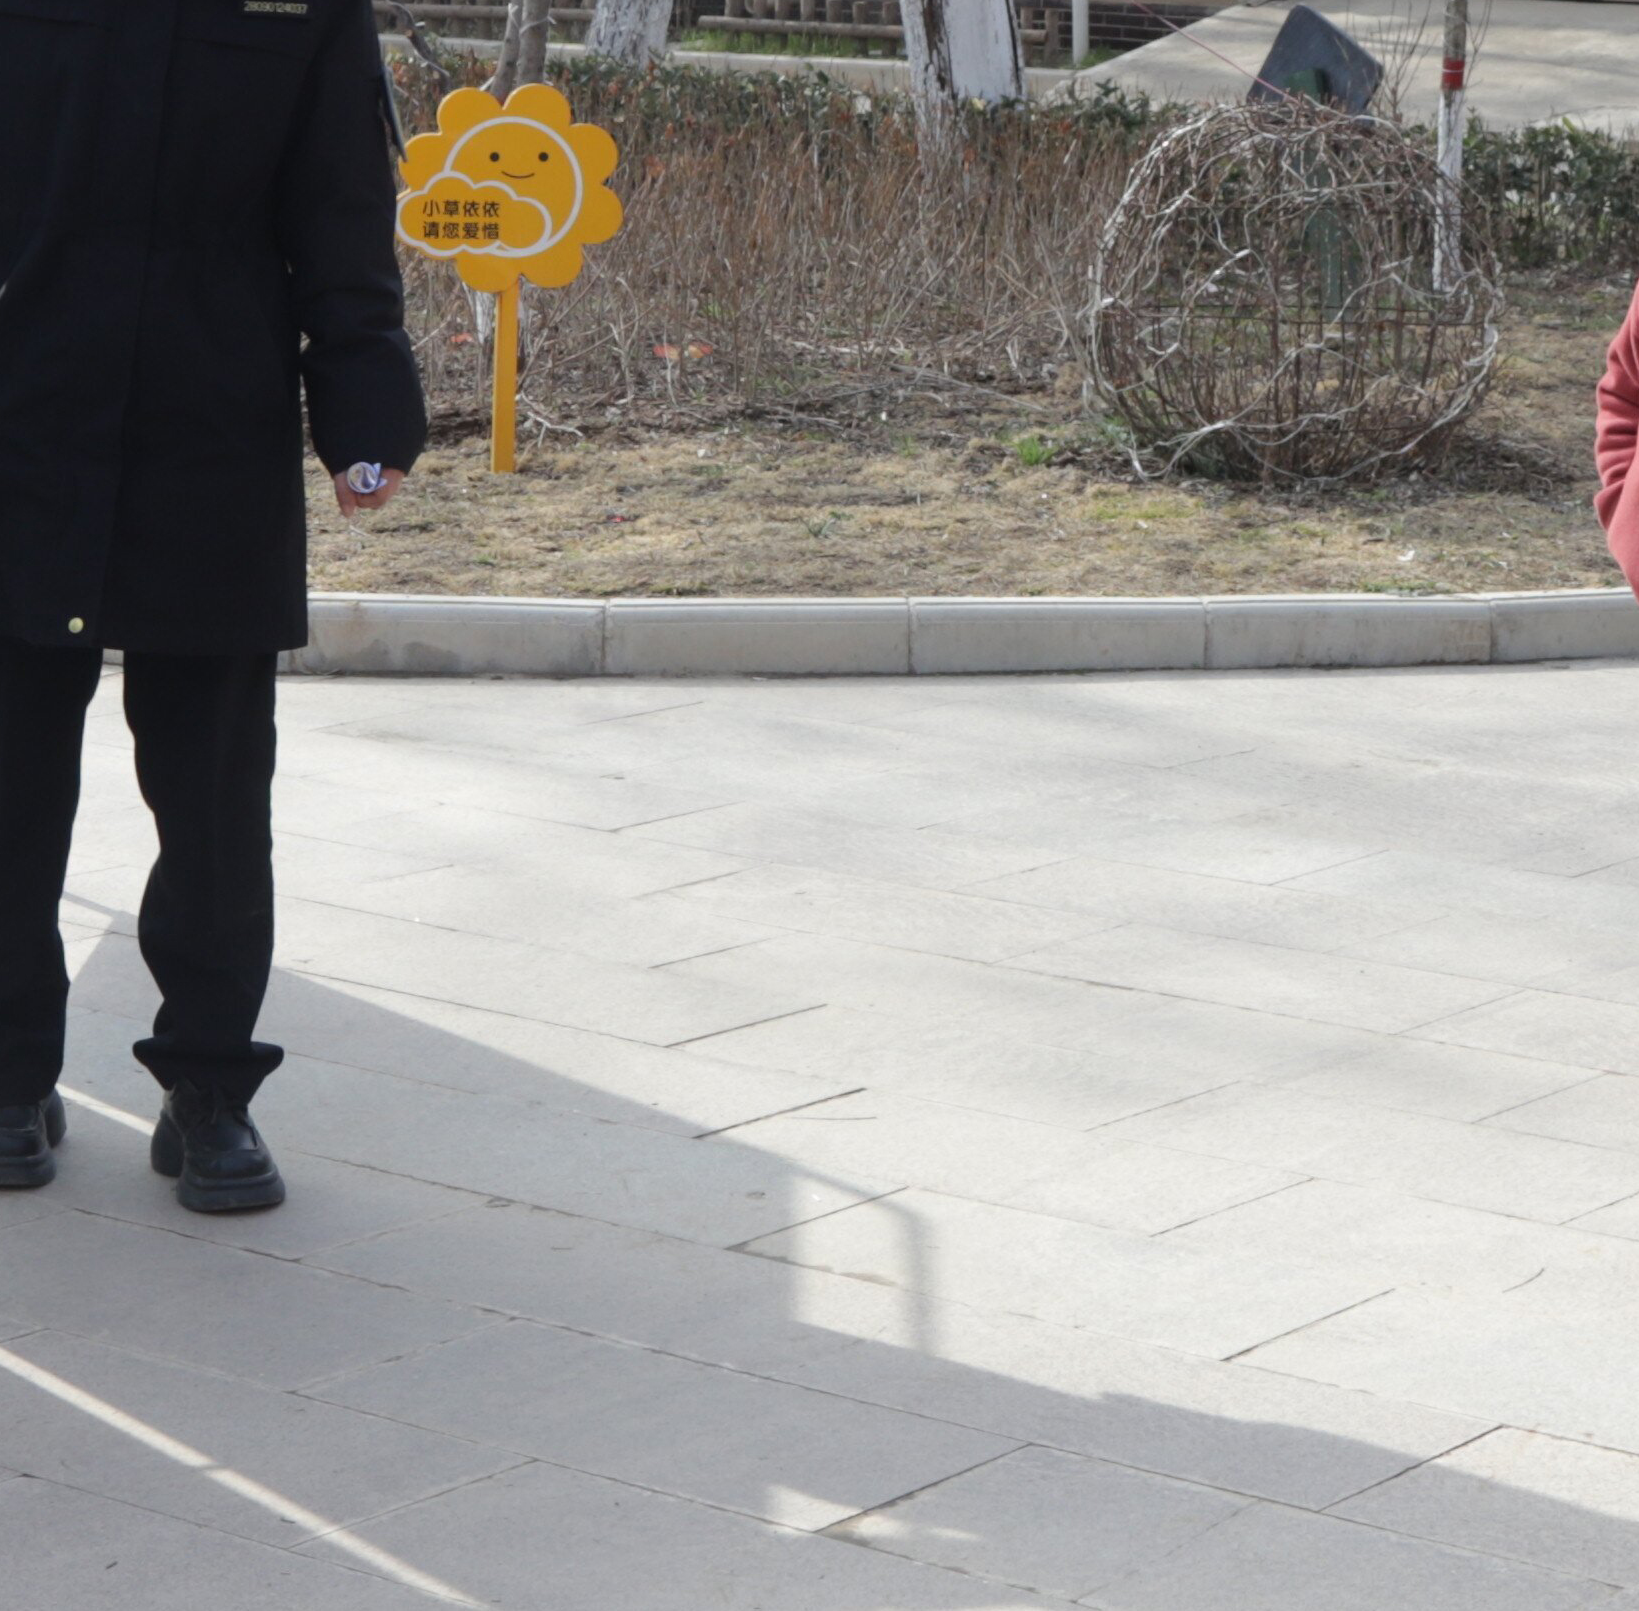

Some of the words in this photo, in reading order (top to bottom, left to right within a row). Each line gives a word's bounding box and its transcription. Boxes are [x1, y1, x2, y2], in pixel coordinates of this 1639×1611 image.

[422, 200, 500, 218] 小草依依
[422, 221, 500, 240] 请您爱惜
